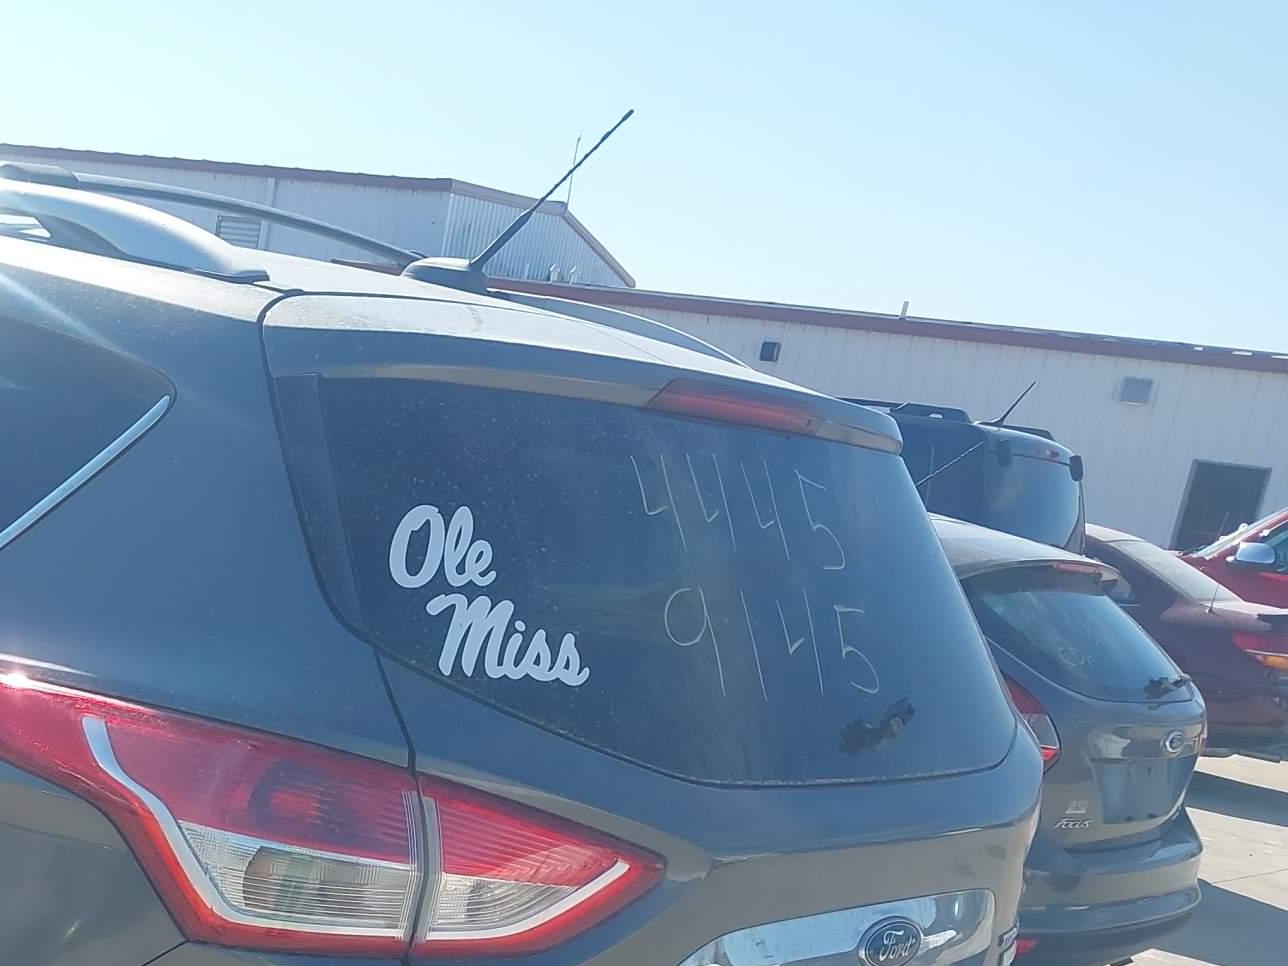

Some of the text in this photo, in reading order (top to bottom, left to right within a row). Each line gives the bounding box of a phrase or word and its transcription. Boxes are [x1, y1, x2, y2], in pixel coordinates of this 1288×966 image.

[388, 504, 497, 588] Ole
[630, 453, 847, 570] 4445
[425, 593, 591, 687] Miss
[664, 584, 880, 702] 9145
[879, 929, 916, 962] Ford
